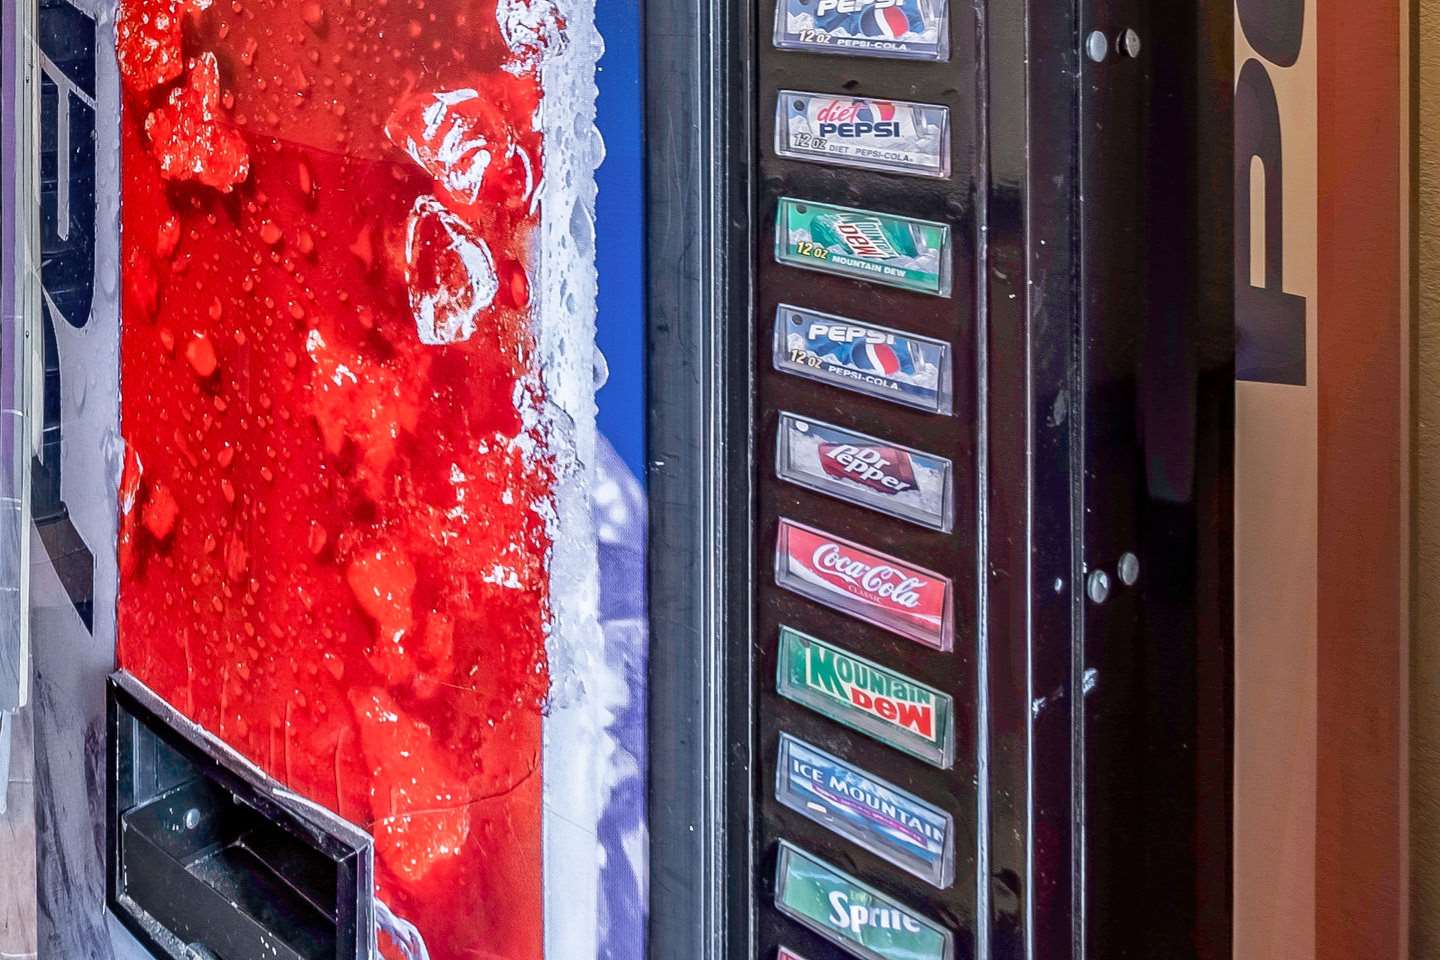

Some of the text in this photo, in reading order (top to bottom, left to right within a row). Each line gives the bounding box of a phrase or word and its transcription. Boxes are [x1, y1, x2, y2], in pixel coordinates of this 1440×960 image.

[799, 29, 814, 42] 12
[837, 39, 907, 50] PEPSI-COLA
[816, 100, 863, 123] diet
[819, 121, 900, 138] PEPSI
[793, 132, 811, 148] 12
[829, 144, 911, 162] DIET PEPSI-COLA
[796, 240, 812, 256] 12
[831, 255, 906, 278] MOUNTAIN DEW
[809, 324, 897, 346] PEPSI
[790, 349, 805, 366] 12
[828, 365, 900, 390] PEPSI-COLA
[826, 443, 911, 491] Pepper
[855, 448, 891, 468] Dr
[793, 758, 824, 784] ICE
[830, 775, 944, 842] MOUNTAIN
[828, 890, 921, 933] Sprite
